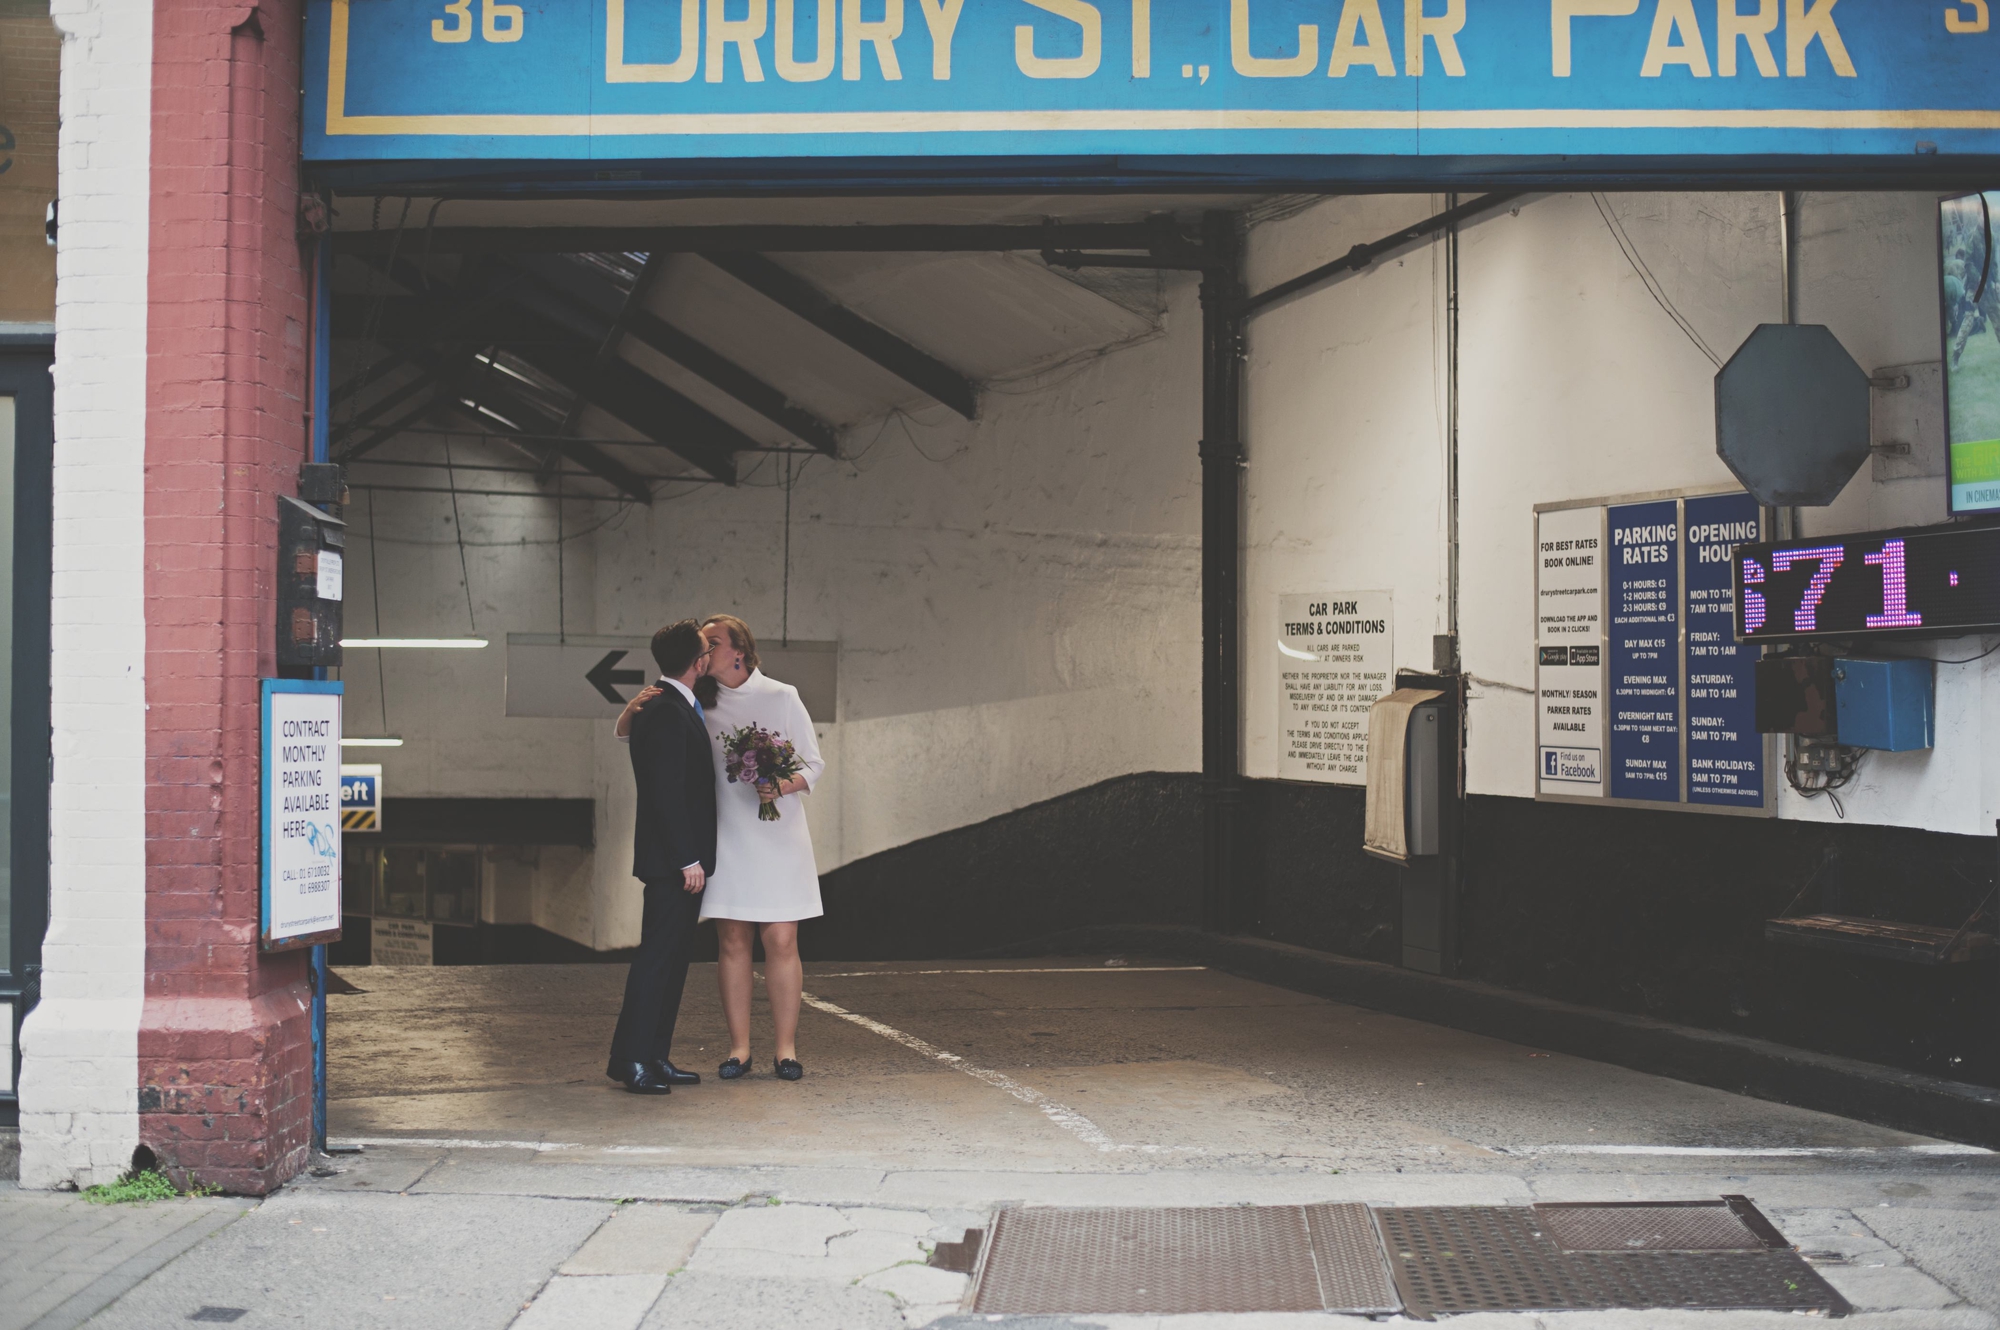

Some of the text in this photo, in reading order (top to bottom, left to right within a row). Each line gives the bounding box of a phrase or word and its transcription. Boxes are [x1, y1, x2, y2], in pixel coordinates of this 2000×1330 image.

[431, 0, 524, 43] 36
[606, 0, 964, 83] DRURY
[1230, 0, 1466, 78] CAR
[1551, 0, 1857, 77] PARK
[1973, 444, 2000, 466] GIR
[1966, 487, 2000, 504] IN CINEMA
[1614, 524, 1676, 546] PARKING
[1689, 521, 1757, 543] OPENING
[1541, 538, 1598, 552] FOR BEST RATES
[1623, 545, 1668, 565] RATES
[1544, 556, 1594, 568] BOOK ONLINE!
[1623, 579, 1666, 589] 0-1 HOURS: €3
[1540, 587, 1598, 597] drurystreetcarpark.com
[1623, 591, 1657, 601] 1-2 HOURS:
[1690, 589, 1719, 599] MON TO
[1309, 601, 1358, 616] CAR PARK
[1623, 603, 1657, 612] 2-3 HOURS:
[1690, 604, 1718, 614] 7AM TO
[1285, 620, 1385, 636] TERMS & CONDITIONS
[1571, 625, 1590, 633] CLICKS!
[1690, 632, 1720, 642] FRIDAY:
[1317, 644, 1329, 652] CARS
[1331, 644, 1340, 652] ARE
[1342, 644, 1360, 652] PARKED
[1624, 639, 1666, 648] DAY MAX €15
[1690, 646, 1736, 655] 7AM TO 1AM
[1577, 653, 1598, 664] App Store
[1282, 672, 1387, 681] NEITHER THE PROPRIETOR NOR THE MANAGER
[1623, 675, 1667, 684] EVENING MAX
[1691, 674, 1734, 684] SATURDAY:
[1285, 683, 1298, 691] SHALL
[1300, 683, 1311, 691] HAVE
[1313, 683, 1322, 691] ANY
[1324, 683, 1344, 691] LIABILITY
[1289, 693, 1316, 701] MISDELIVERY
[1572, 690, 1597, 699] SEASON
[1691, 689, 1737, 698] 8AM TO 1AM
[1301, 703, 1338, 712] ANY VEHICLE OR
[1547, 706, 1592, 715] PARKER RATES
[1618, 711, 1673, 721] OVERNIGHT RATE
[1311, 721, 1320, 729] YOU
[1322, 721, 1328, 729] DO
[1342, 722, 1359, 730] ACCEPT
[1553, 722, 1586, 732] AVAILABLE
[1691, 717, 1725, 727] SUNDAY:
[283, 720, 330, 737] CONTRACT
[1297, 730, 1311, 738] TERMS
[1313, 731, 1322, 739] AND
[1324, 732, 1350, 740] CONDITIONS
[1691, 731, 1737, 741] 9AM TO 7PM
[1292, 741, 1308, 749] PLEASE
[1309, 742, 1322, 750] DRIVE
[1324, 742, 1344, 750] DIRECTLY
[1347, 743, 1353, 751] TO
[1355, 744, 1364, 752] THE
[283, 745, 327, 763] MONTHLY
[1298, 752, 1325, 760] IMMEDIATELY
[1327, 753, 1341, 761] LEAVE
[1343, 754, 1352, 762] THE
[1354, 755, 1364, 763] CAR
[1561, 752, 1571, 761] Find
[1306, 762, 1325, 771] WITHOUT
[1339, 764, 1358, 773] CHARGE
[1625, 759, 1667, 769] SUNDAY MAX
[1692, 759, 1755, 771] BANK HOLIDAYS:
[1561, 763, 1596, 778] Facebook
[283, 769, 322, 788] PARKING
[1655, 772, 1668, 781] €15
[1692, 773, 1738, 784] 9AM TO 7PM
[341, 781, 369, 801] eft
[283, 794, 330, 813] AVAILABLE
[283, 820, 306, 839] HERE
[283, 870, 299, 881] CALL:
[299, 868, 306, 879] 01
[300, 883, 306, 894] 01
